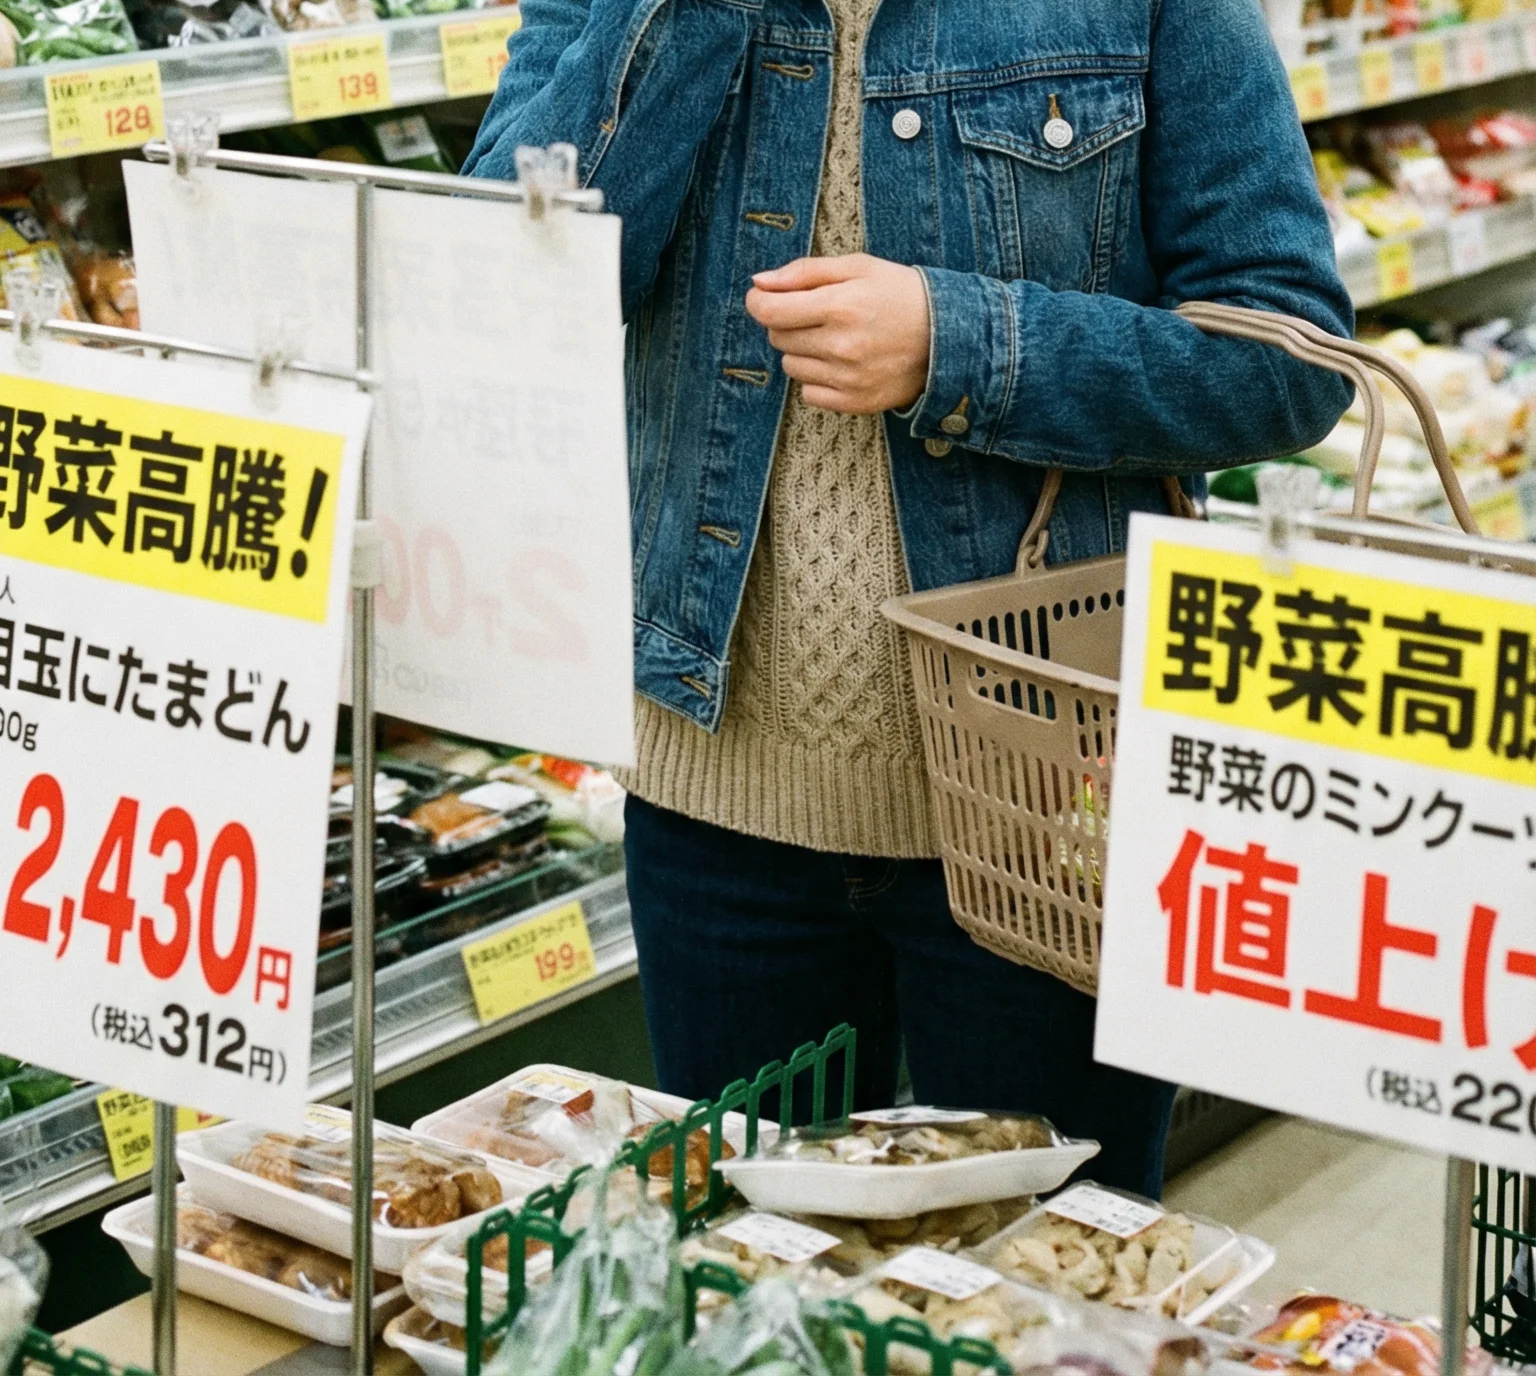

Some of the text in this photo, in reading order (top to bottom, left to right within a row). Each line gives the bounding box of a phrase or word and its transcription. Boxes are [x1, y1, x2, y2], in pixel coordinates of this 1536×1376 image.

[0, 404, 329, 582] 野菜高騰!
[3, 773, 293, 1011] 2,430円
[535, 941, 574, 982] 199
[91, 1001, 287, 1086] (税込312円)
[1366, 1065, 1536, 1138] (税込22
